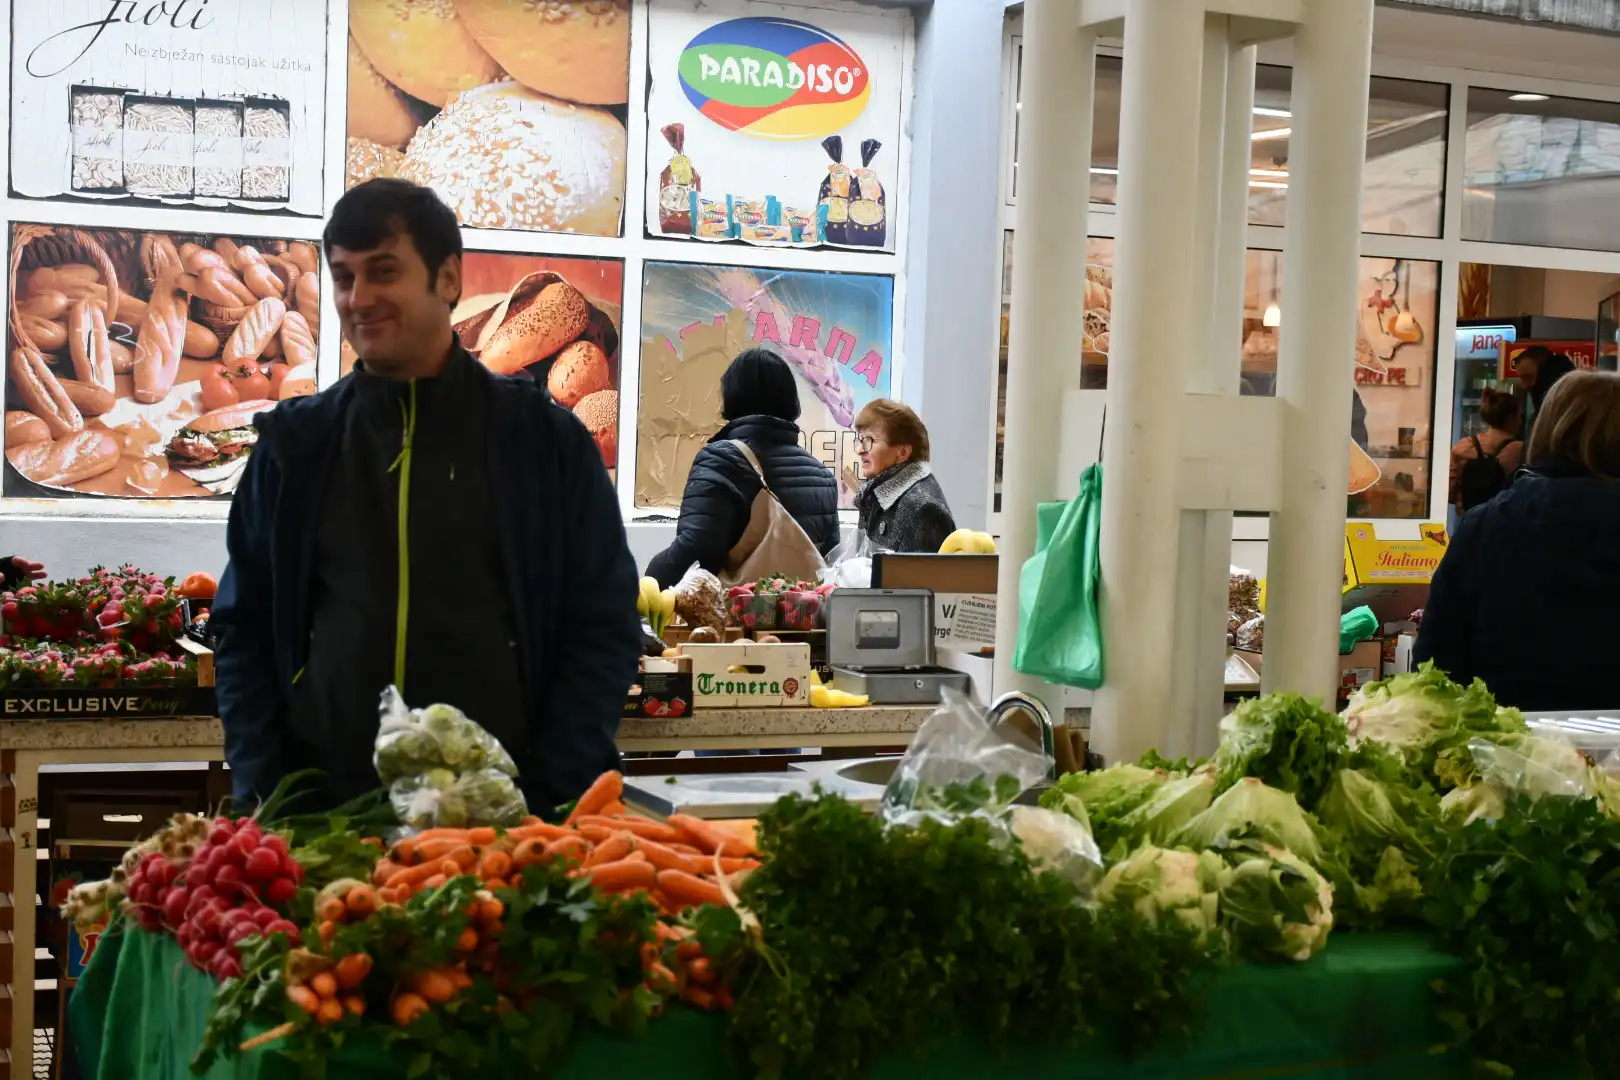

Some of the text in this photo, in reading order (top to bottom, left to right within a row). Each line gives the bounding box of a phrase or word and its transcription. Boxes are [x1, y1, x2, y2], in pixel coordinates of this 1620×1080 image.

[210, 51, 266, 67] sastojak
[272, 57, 312, 72] užitka
[1375, 550, 1438, 570] Italiano
[696, 672, 781, 695] Tronera
[4, 696, 139, 713] EXCLUSIVE
